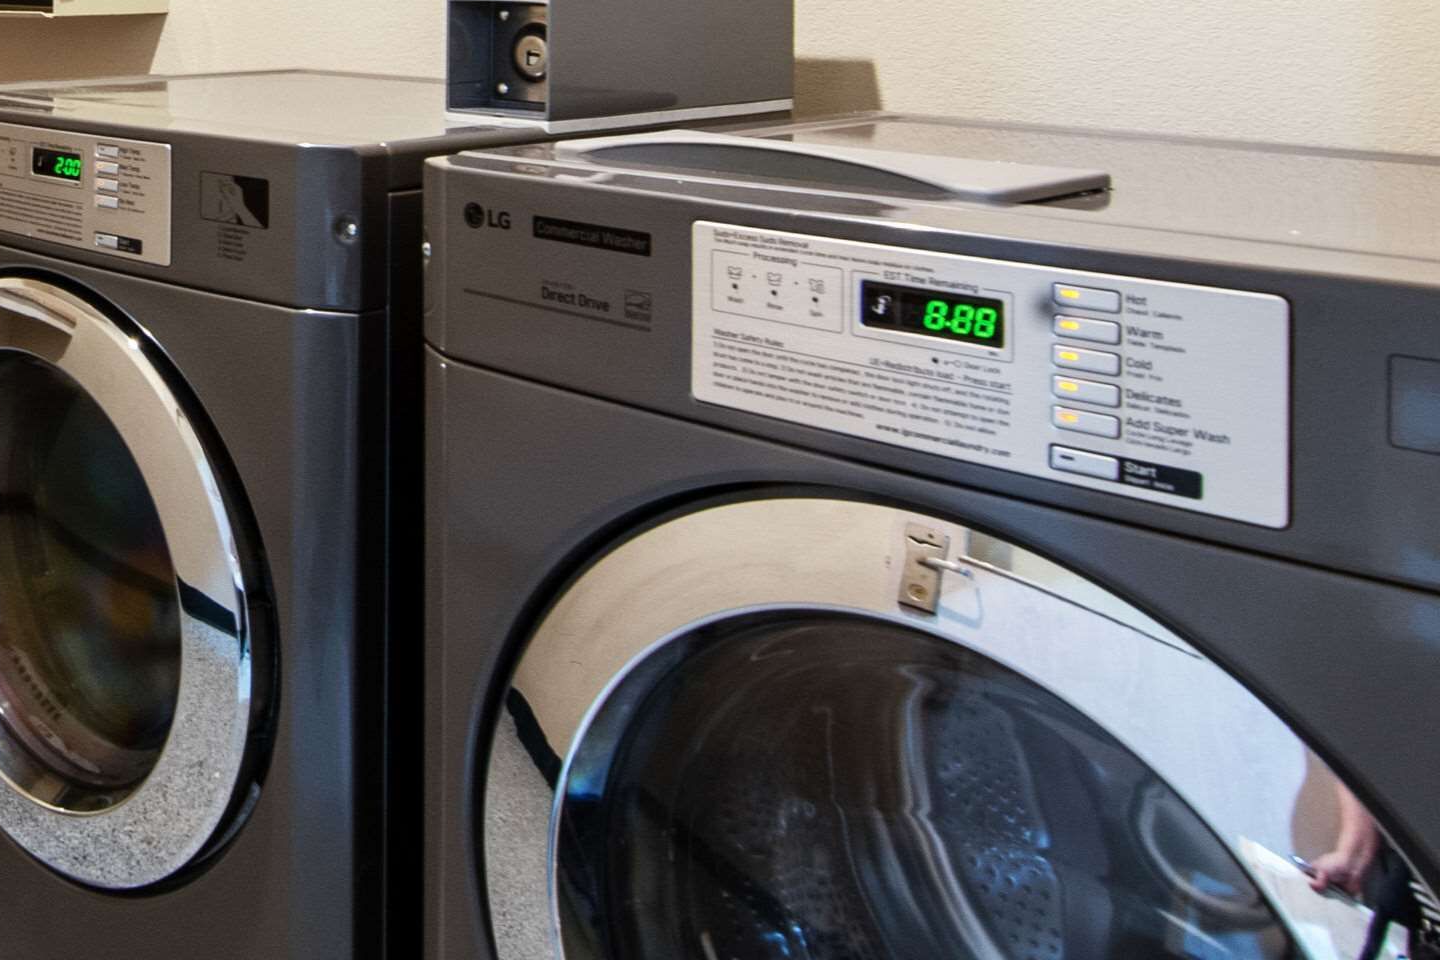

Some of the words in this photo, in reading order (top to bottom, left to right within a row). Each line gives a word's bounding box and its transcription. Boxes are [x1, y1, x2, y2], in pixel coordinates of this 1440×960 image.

[487, 209, 511, 230] LG
[601, 231, 649, 251] Washer
[753, 251, 798, 267] Processing
[904, 272, 926, 284] Time
[928, 276, 979, 294] Remaining
[541, 285, 576, 305] Direct
[578, 294, 610, 312] Drive
[1125, 294, 1147, 306] Hot
[1126, 326, 1164, 340] Warm
[1125, 357, 1153, 370] Cold
[1125, 388, 1182, 408] Delicates
[1126, 417, 1151, 430] Add
[1153, 421, 1189, 437] Super
[1193, 429, 1231, 445] Wash
[1123, 461, 1157, 478] Start
